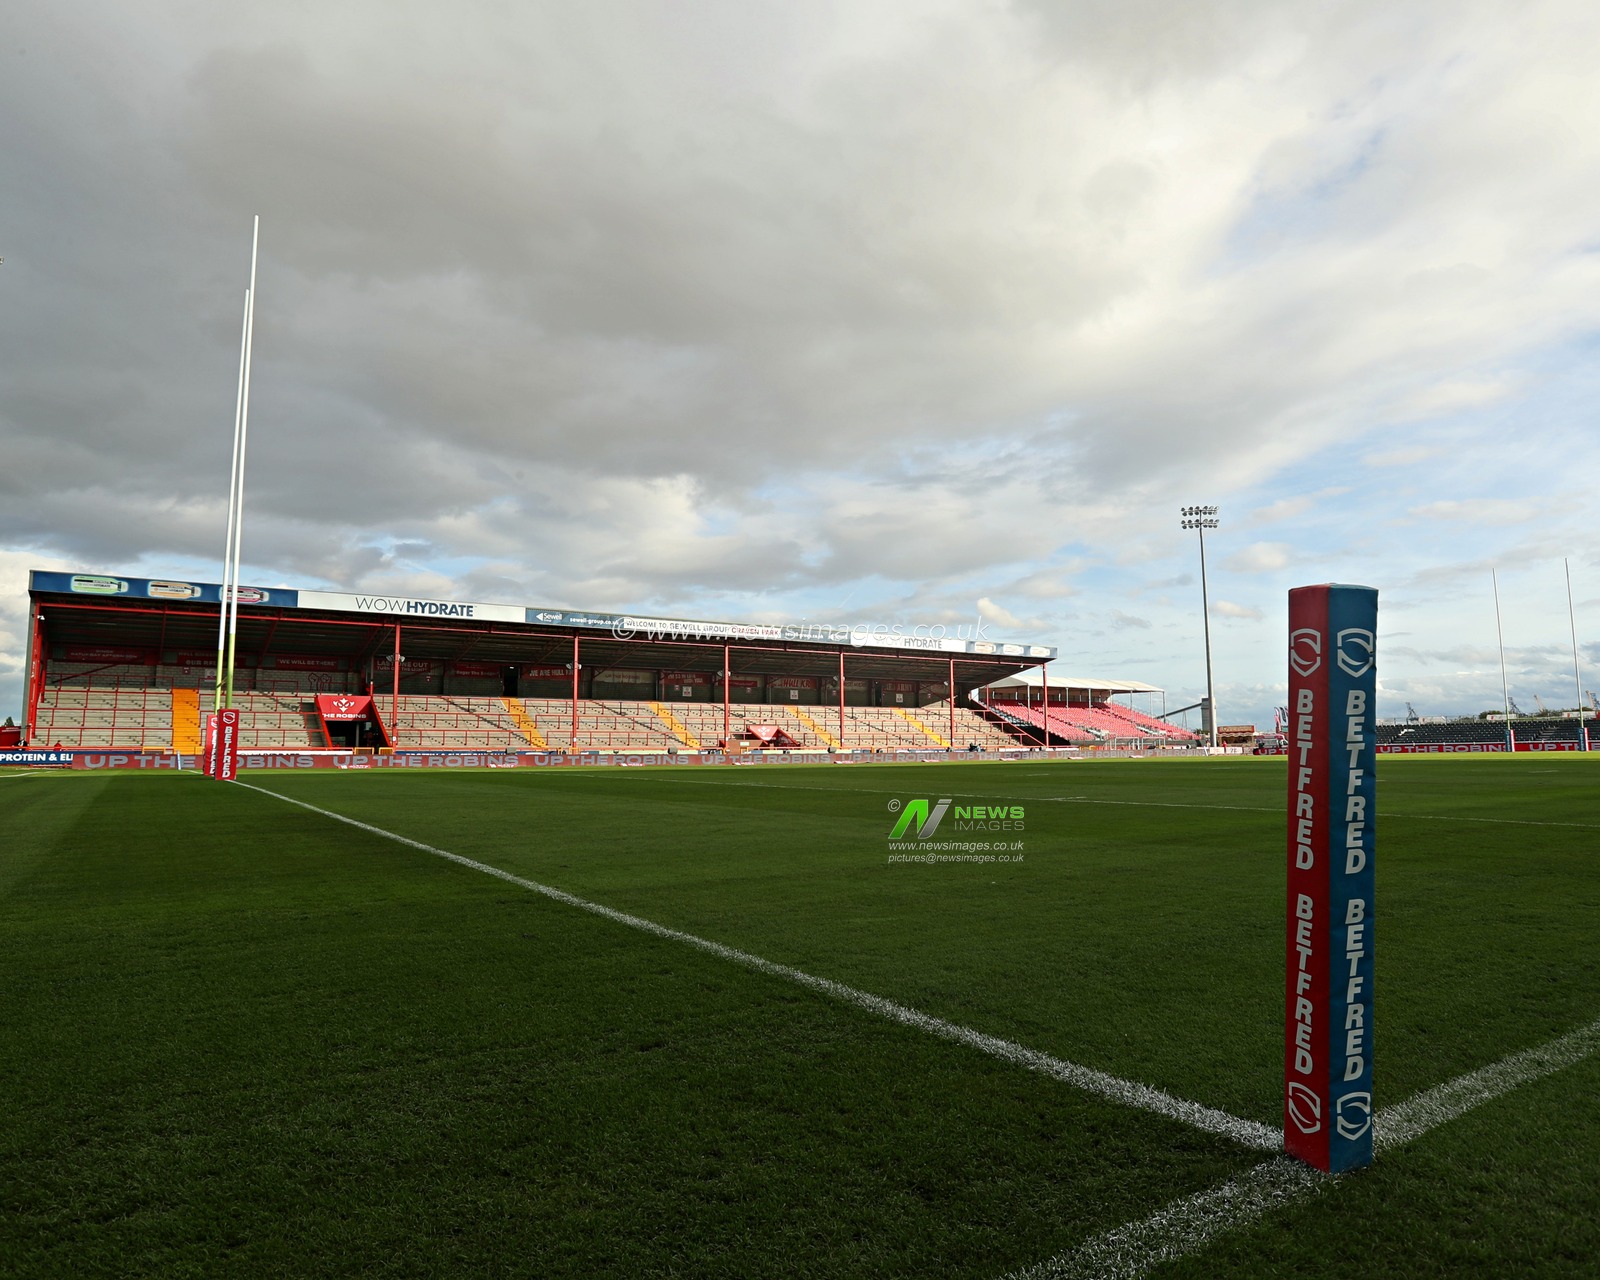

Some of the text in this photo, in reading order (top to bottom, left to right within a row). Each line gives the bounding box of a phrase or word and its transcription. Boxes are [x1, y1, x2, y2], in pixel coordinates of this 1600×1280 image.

[543, 612, 563, 621] Sewell
[222, 726, 233, 778] BETFRED
[1529, 743, 1557, 751] UP
[0, 753, 47, 762] PROTEIN
[48, 753, 58, 762] &
[84, 755, 315, 769] UP THE BINS
[333, 755, 519, 768] UP THE ROBINS
[534, 755, 689, 766] UP THE ROBINS
[701, 754, 831, 765] UP THE ROBINS
[841, 753, 949, 763] UP THE ROBINS
[1296, 689, 1314, 871] BETFRED
[1345, 690, 1366, 875] BETFRED
[1295, 893, 1313, 1075] BETFRED
[1344, 899, 1365, 1082] BETFRED
